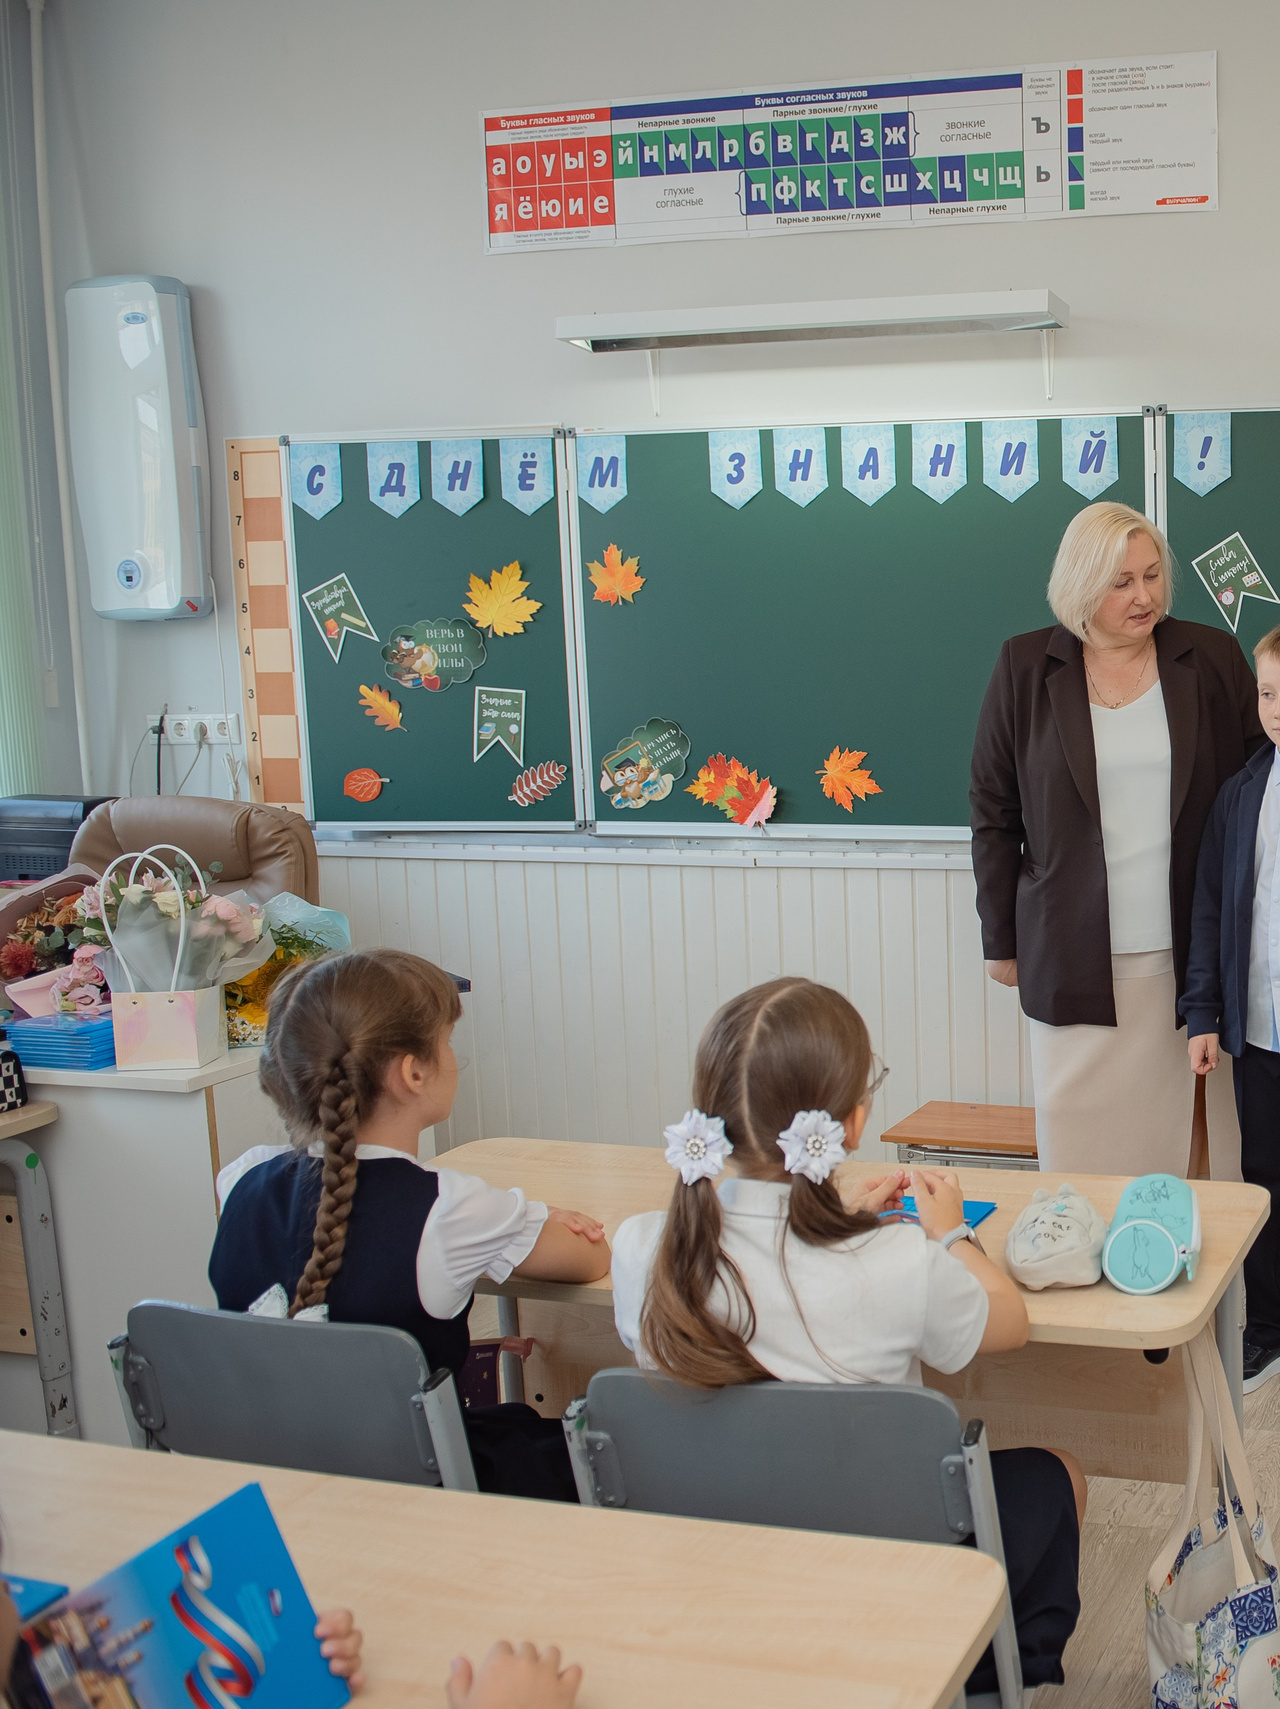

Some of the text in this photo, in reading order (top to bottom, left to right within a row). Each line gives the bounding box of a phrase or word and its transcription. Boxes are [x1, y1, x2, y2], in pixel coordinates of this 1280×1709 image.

[755, 90, 868, 107] Буквы согласных звуков
[772, 103, 878, 118] Парные звонкие/глухие
[500, 113, 595, 128] Буквы гласных звуков
[638, 116, 716, 129] Непарные звонкие
[946, 120, 986, 130] звонкие
[940, 131, 992, 142] согласные
[618, 126, 907, 165] й н м л р б в г д з ж
[492, 149, 607, 177] а о у ы э
[751, 166, 1022, 205] п ф к т с ш х ц ч щ
[664, 186, 694, 197] глухие
[494, 195, 609, 221] я ё ю и е
[656, 197, 703, 209] согласные
[928, 204, 1007, 215] Непарные глухие
[776, 212, 881, 225] Парные звонкие/глухие
[233, 471, 240, 481] 8
[305, 464, 325, 496] С
[236, 516, 242, 526] 7
[238, 559, 244, 569] 6
[242, 603, 248, 613] 5
[426, 629, 464, 638] ВЕРЬ В
[244, 646, 251, 656] 4
[248, 689, 254, 699] 3
[251, 732, 258, 742] 2
[255, 775, 260, 785] 1
